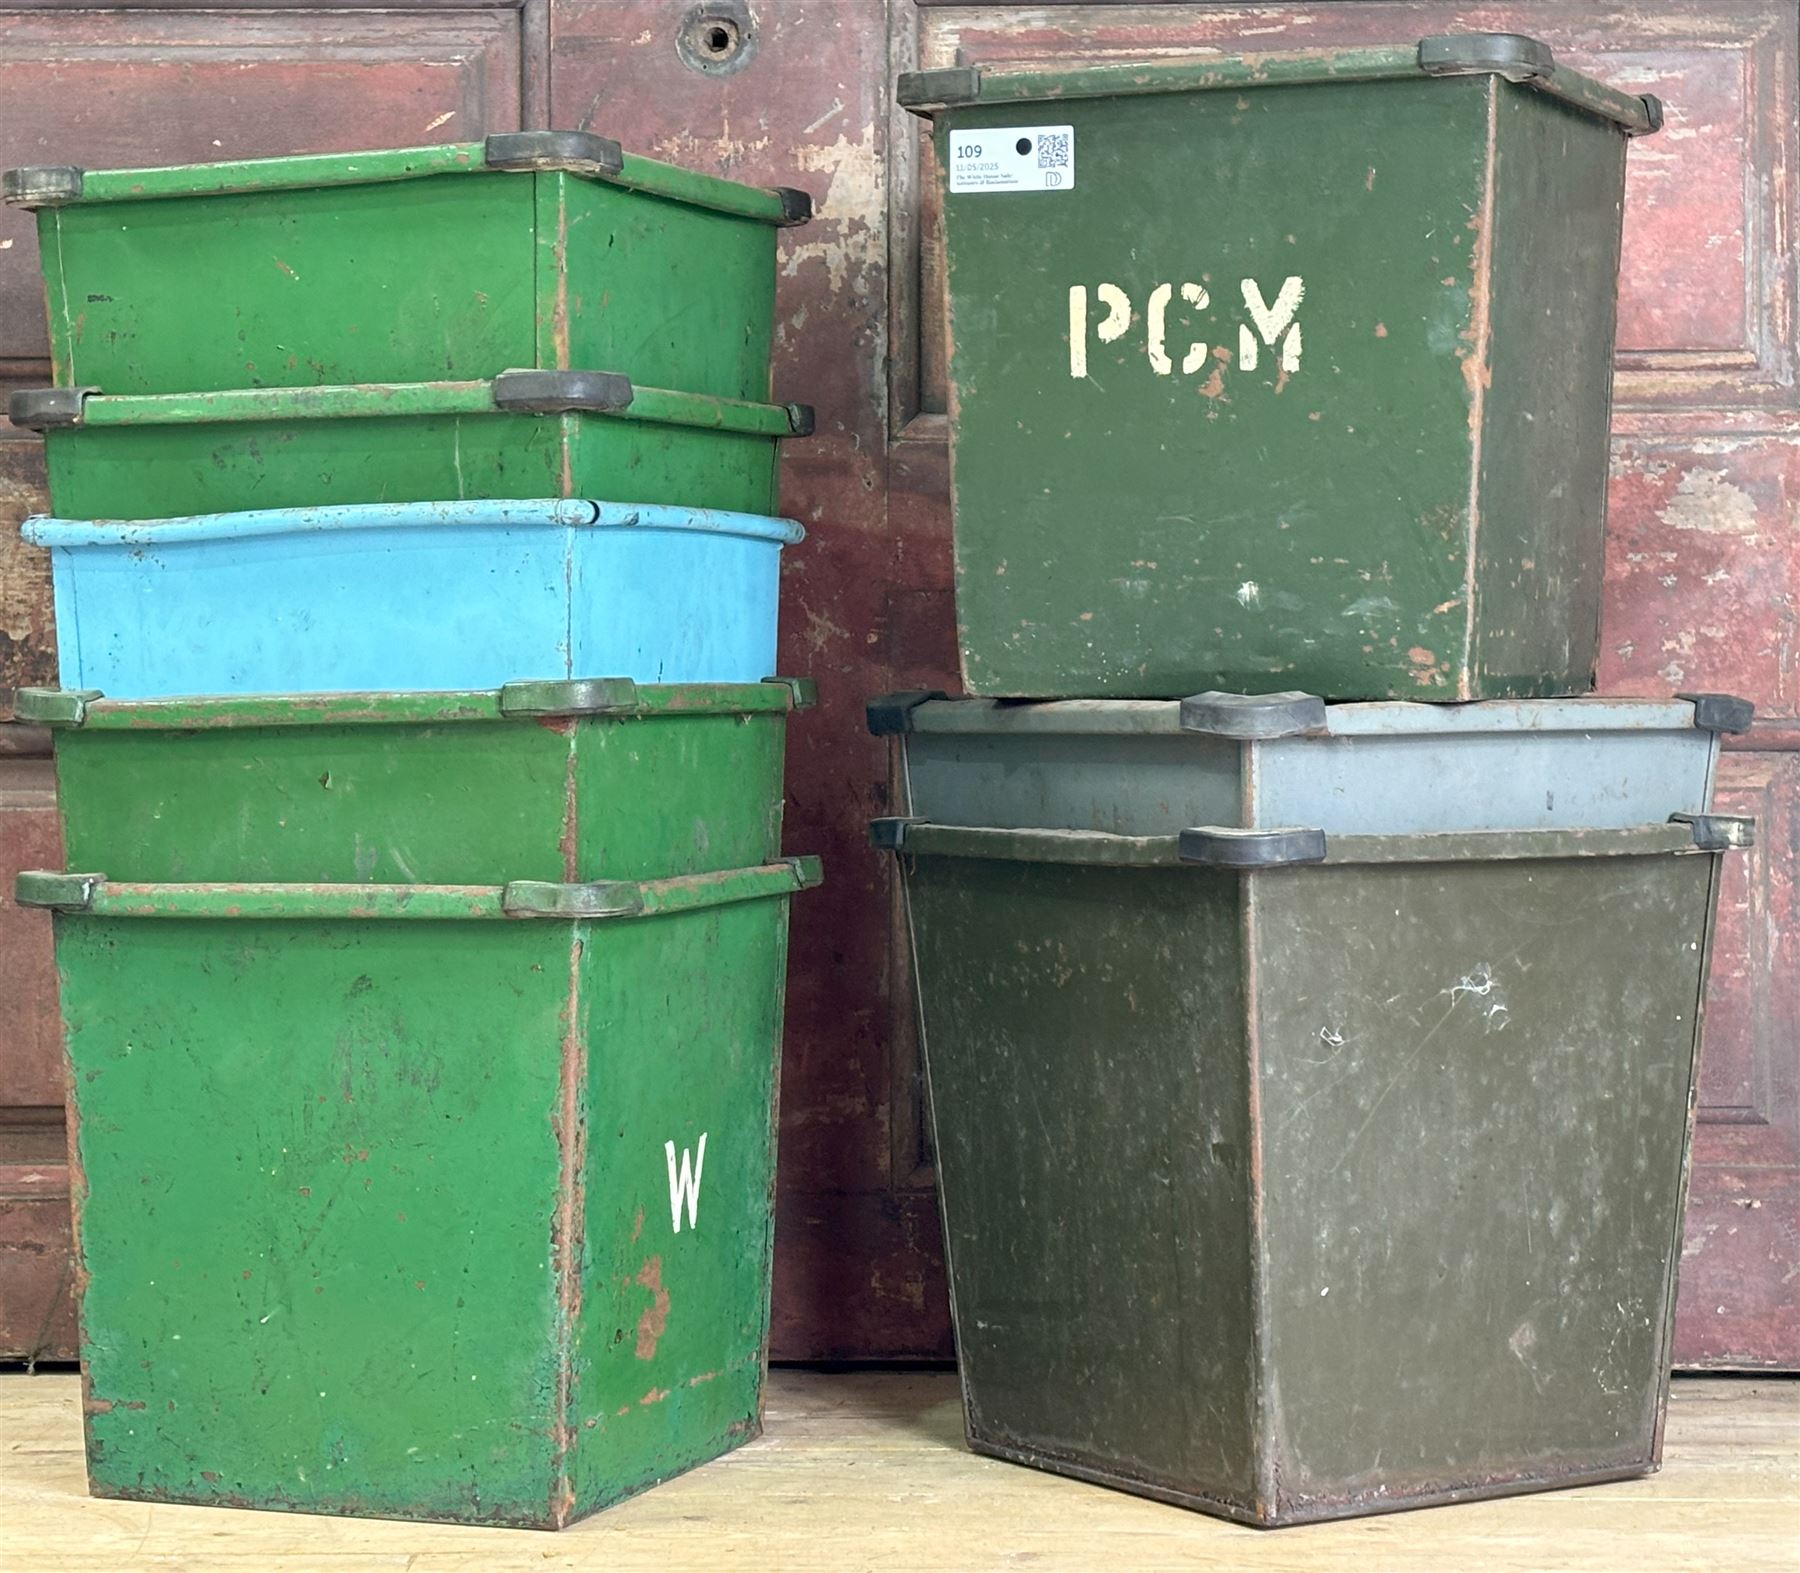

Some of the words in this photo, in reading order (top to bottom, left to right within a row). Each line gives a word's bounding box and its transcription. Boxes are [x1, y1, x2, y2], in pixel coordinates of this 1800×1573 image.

[956, 162, 999, 171] 11/05/2025
[957, 145, 982, 158] 109
[1069, 276, 1306, 379] PCM
[664, 1132, 708, 1234] W
